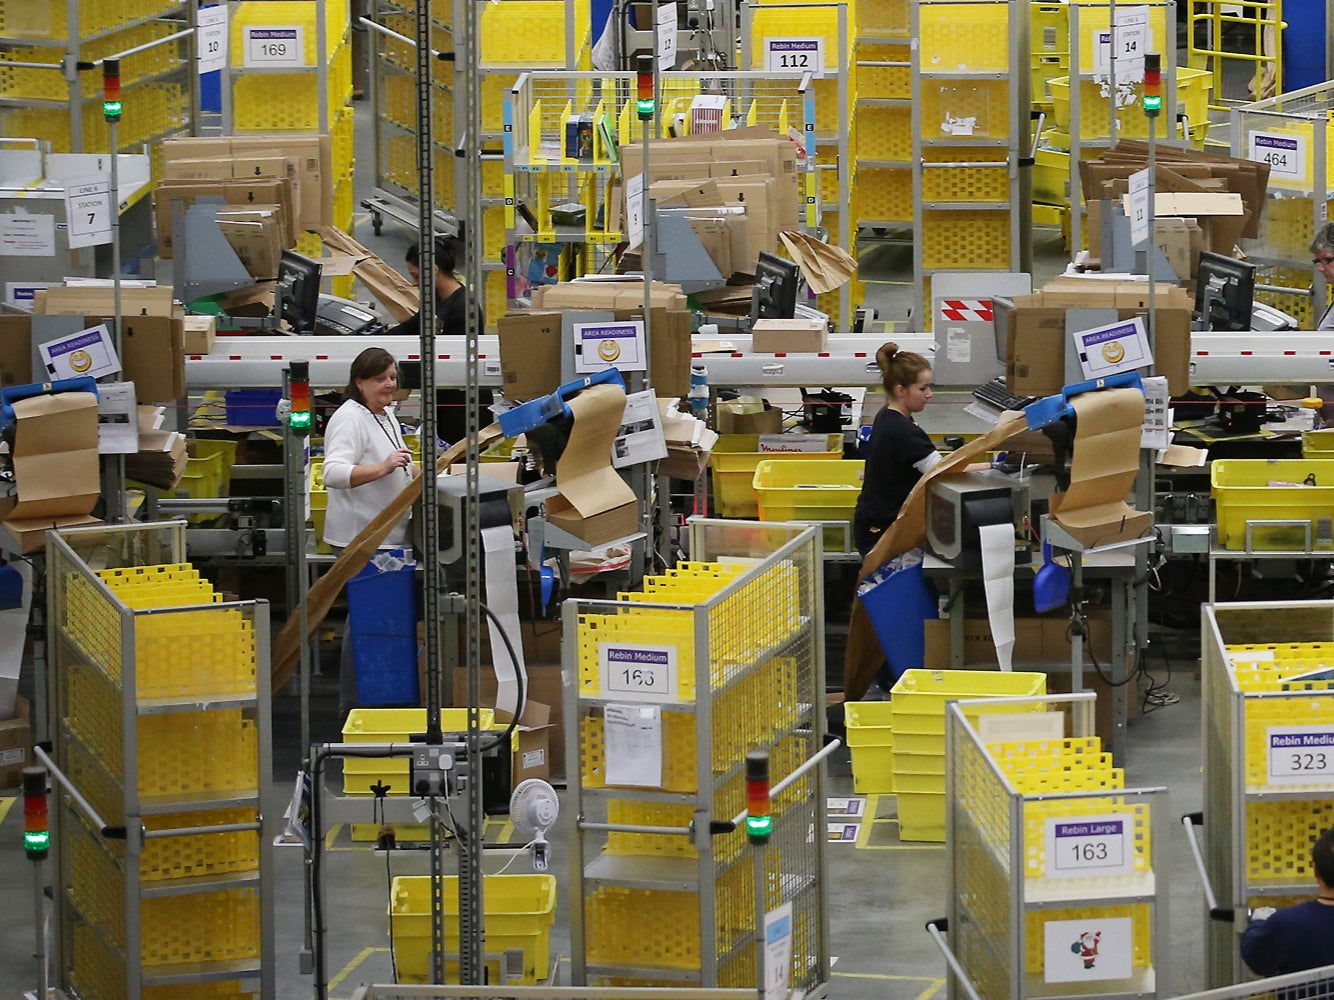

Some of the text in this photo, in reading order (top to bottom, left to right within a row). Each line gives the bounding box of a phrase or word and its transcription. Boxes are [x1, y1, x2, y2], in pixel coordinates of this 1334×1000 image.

[208, 41, 219, 53] 10
[261, 43, 286, 56] 169
[791, 42, 817, 50] Medium
[1125, 41, 1137, 53] 14
[779, 54, 808, 67] 112
[1263, 152, 1287, 167] 464
[77, 200, 103, 209] STATION
[87, 212, 96, 225] 7
[1085, 328, 1135, 343] AREA READINESS
[52, 334, 99, 354] AREA READINESS
[760, 443, 803, 453] Moulinex
[609, 650, 667, 664] Rebin Medium
[1273, 735, 1301, 746] Rebin
[1291, 753, 1327, 771] 323
[1062, 823, 1117, 835] Rebin Large
[1072, 843, 1107, 861] 163
